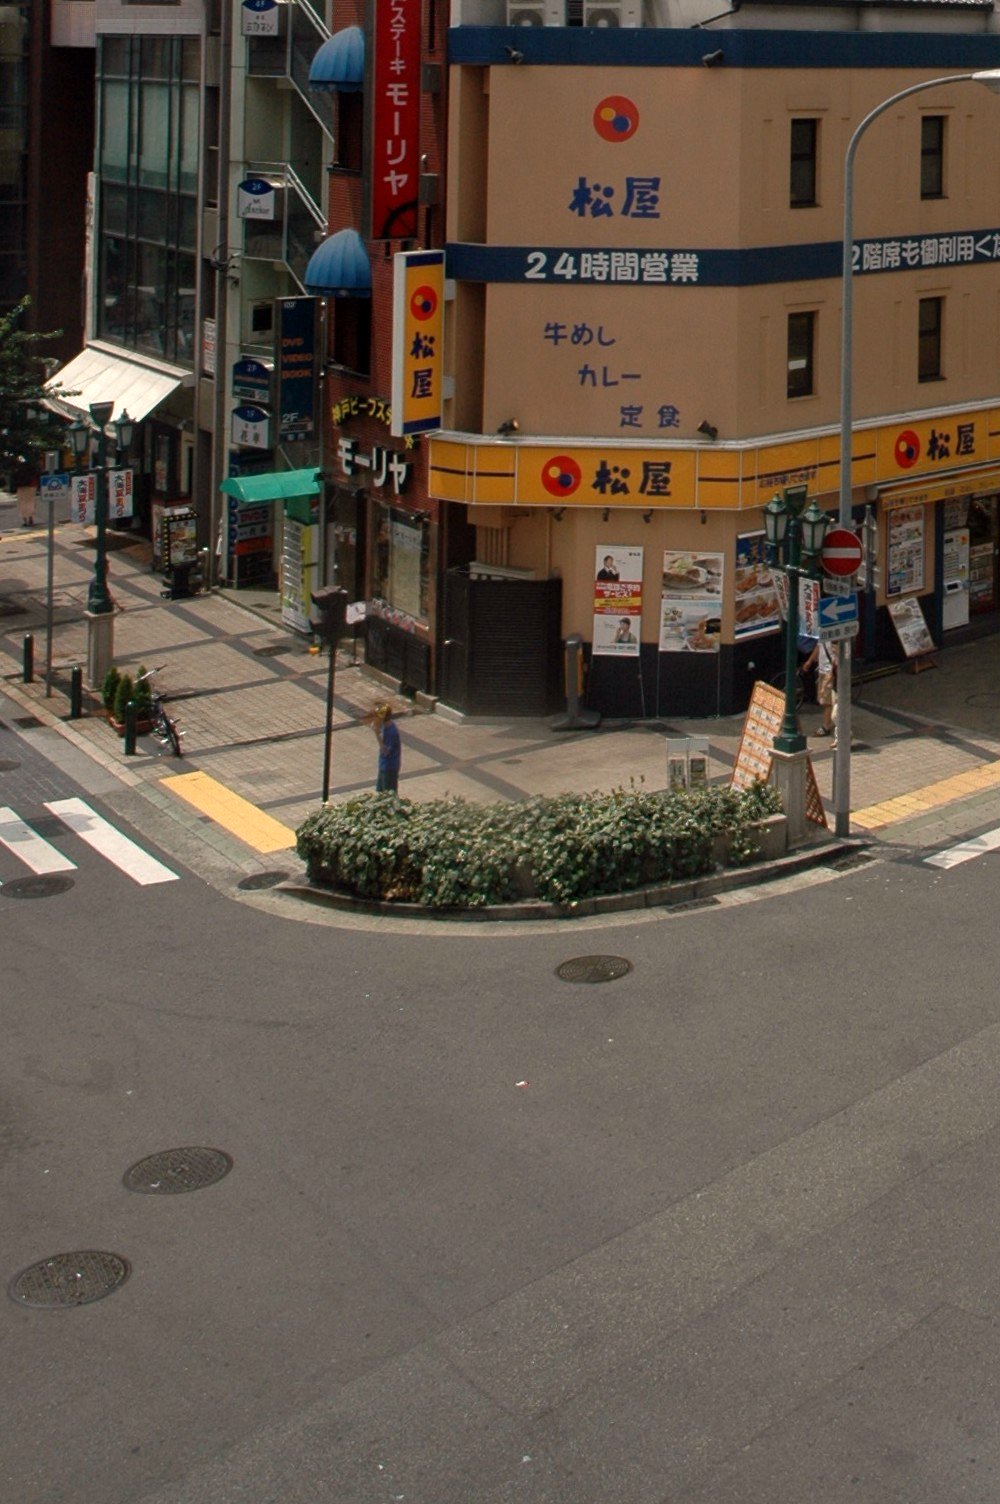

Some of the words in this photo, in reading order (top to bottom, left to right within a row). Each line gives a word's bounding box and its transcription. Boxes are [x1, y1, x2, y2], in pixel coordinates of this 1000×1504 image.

[384, 83, 409, 196] モーリヤ
[568, 176, 662, 219] 松屋
[524, 251, 700, 283] 24時間営業
[544, 322, 617, 347] 牛めし
[409, 331, 436, 400] 松屋
[578, 363, 643, 388] カレー
[281, 411, 299, 424] 2F
[619, 404, 681, 429] 定食
[926, 422, 976, 460] 松屋
[337, 437, 409, 495] モーリヤ
[591, 460, 672, 497] 松屋
